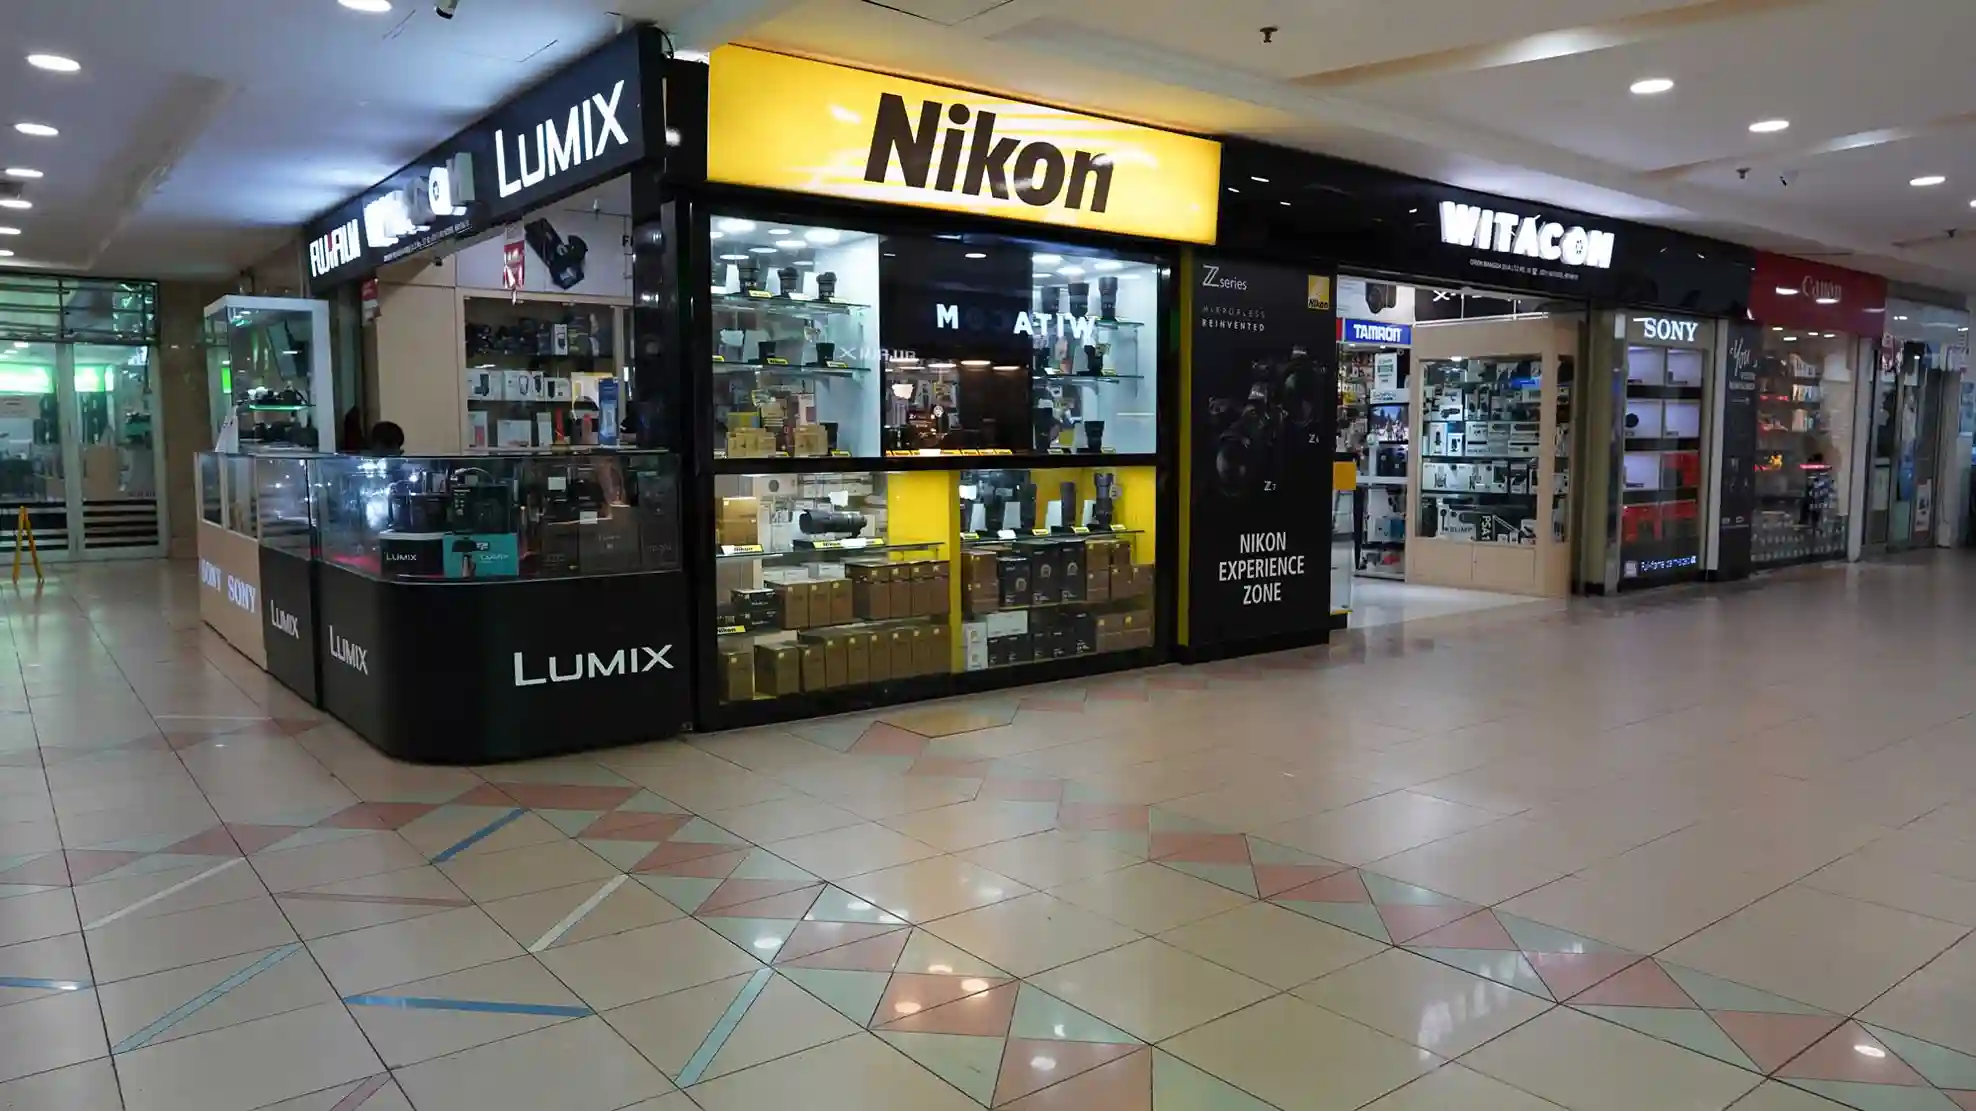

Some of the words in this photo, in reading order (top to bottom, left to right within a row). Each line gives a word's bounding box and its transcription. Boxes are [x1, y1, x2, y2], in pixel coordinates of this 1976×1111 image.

[495, 79, 629, 198] LUMIX
[863, 92, 1115, 213] Nikon
[1219, 275, 1248, 291] series
[1801, 275, 1843, 299] Canon
[1201, 318, 1265, 332] REINVENTED
[1353, 324, 1402, 342] TAMRON
[1643, 317, 1699, 342] SONY
[1239, 531, 1287, 554] NIKON
[386, 552, 417, 561] LUMIX
[1218, 555, 1305, 582] EXPERIENCE
[227, 573, 256, 613] SONY
[1242, 582, 1282, 605] ZONE
[270, 599, 300, 640] LUMIX
[329, 624, 369, 676] LUMIX
[513, 643, 675, 687] LUMIX
